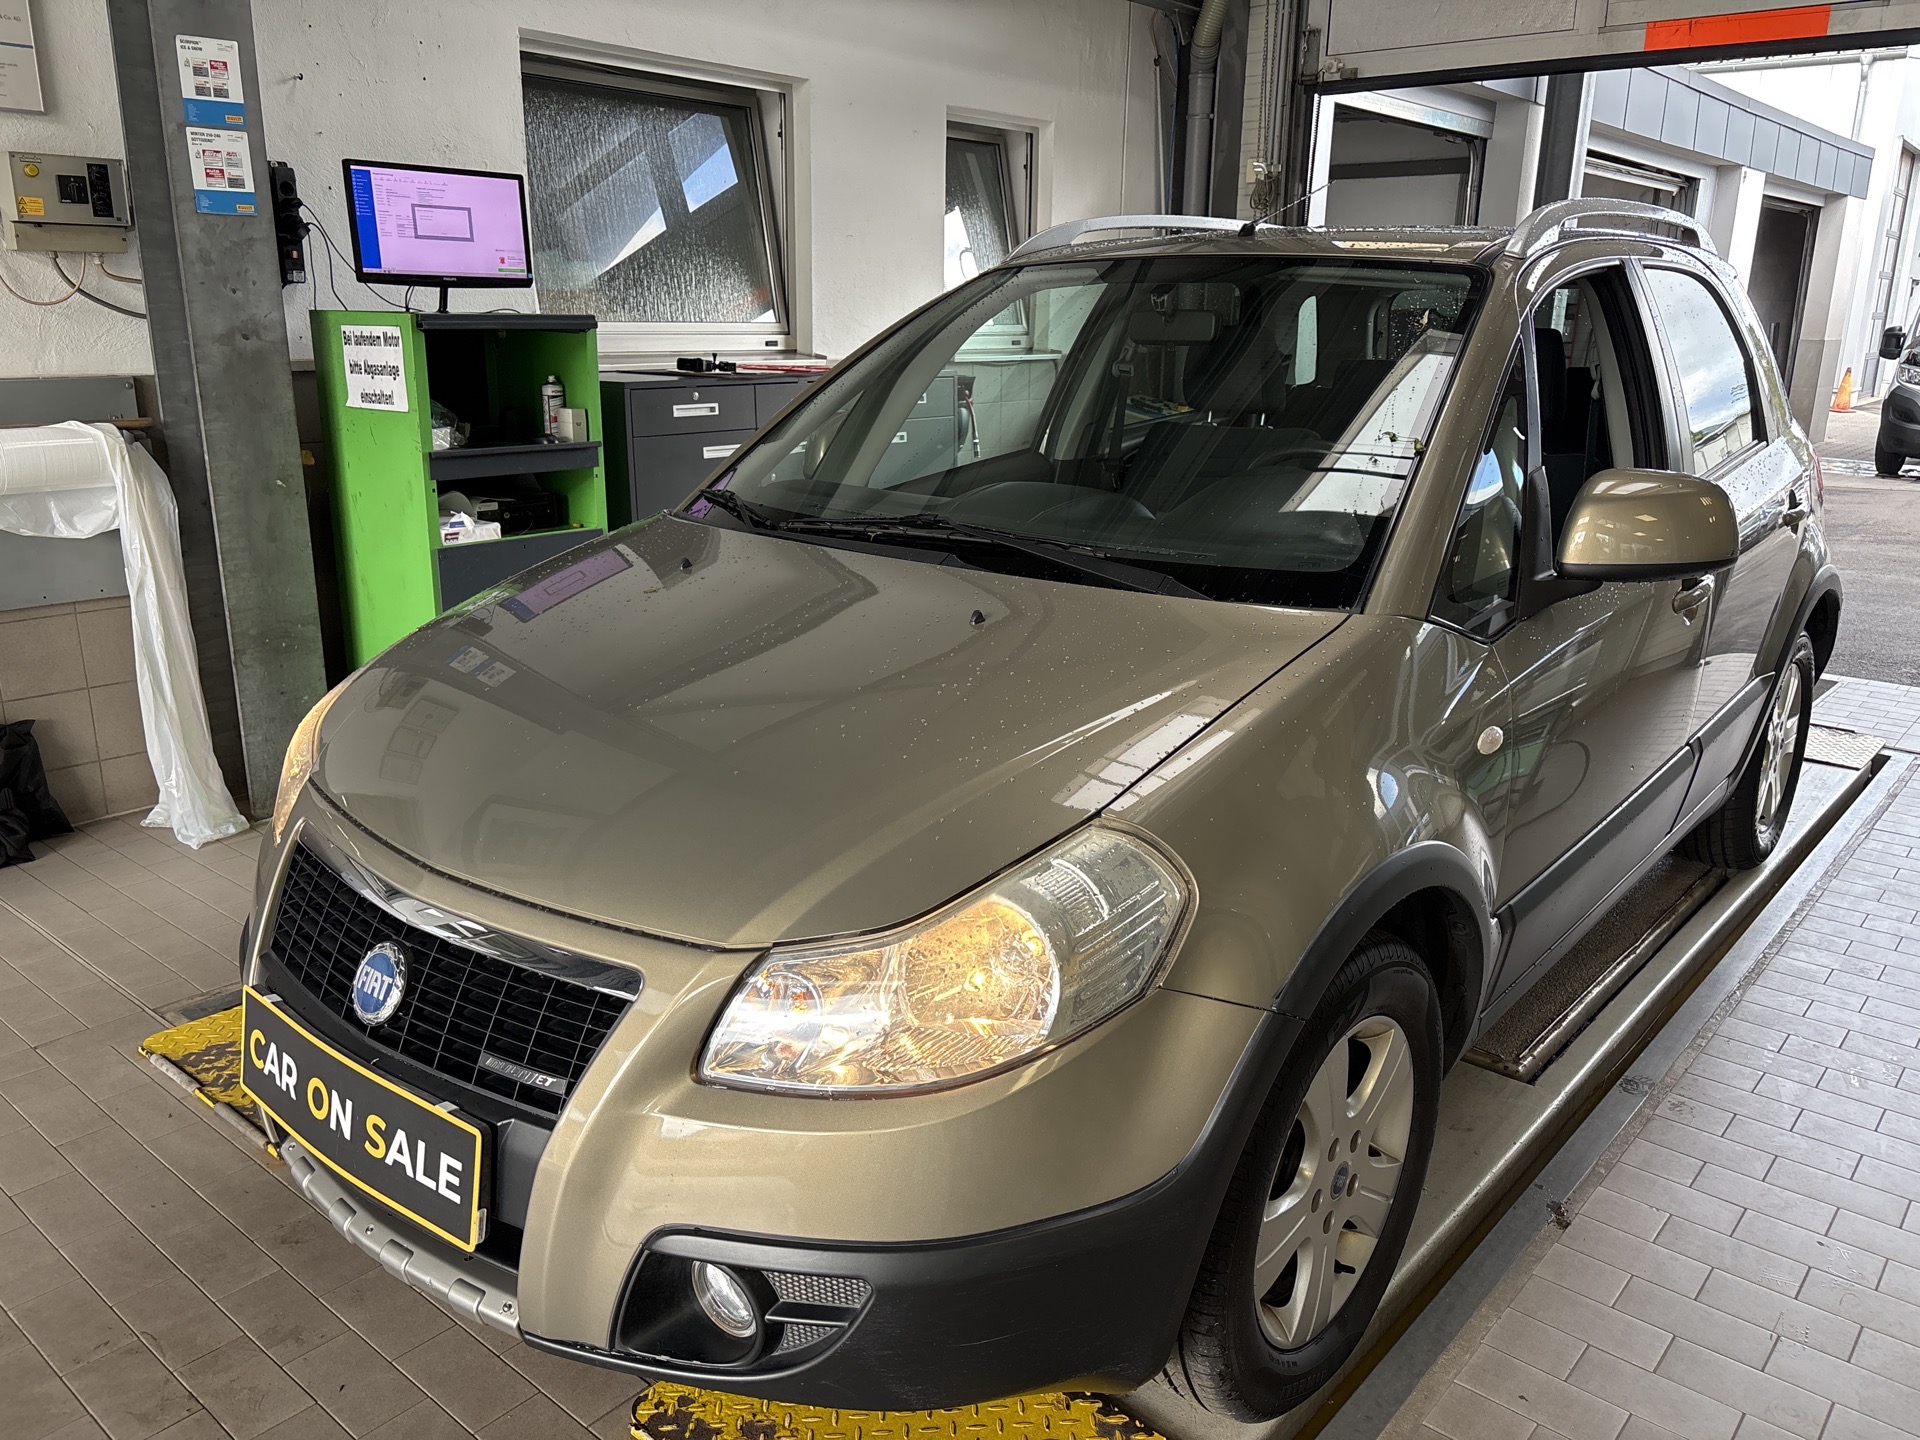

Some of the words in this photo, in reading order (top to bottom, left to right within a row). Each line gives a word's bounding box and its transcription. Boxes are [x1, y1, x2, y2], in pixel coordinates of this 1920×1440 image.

[343, 330, 353, 346] Bei
[353, 330, 382, 347] laufendem
[382, 331, 400, 347] Motor
[349, 359, 362, 375] bitte
[363, 359, 400, 380] Abgasanlage
[360, 388, 395, 405] einschalten!
[356, 965, 394, 1001] FIAT
[249, 1028, 298, 1101] CAR
[306, 1076, 353, 1141] ON
[364, 1113, 463, 1205] SALE
